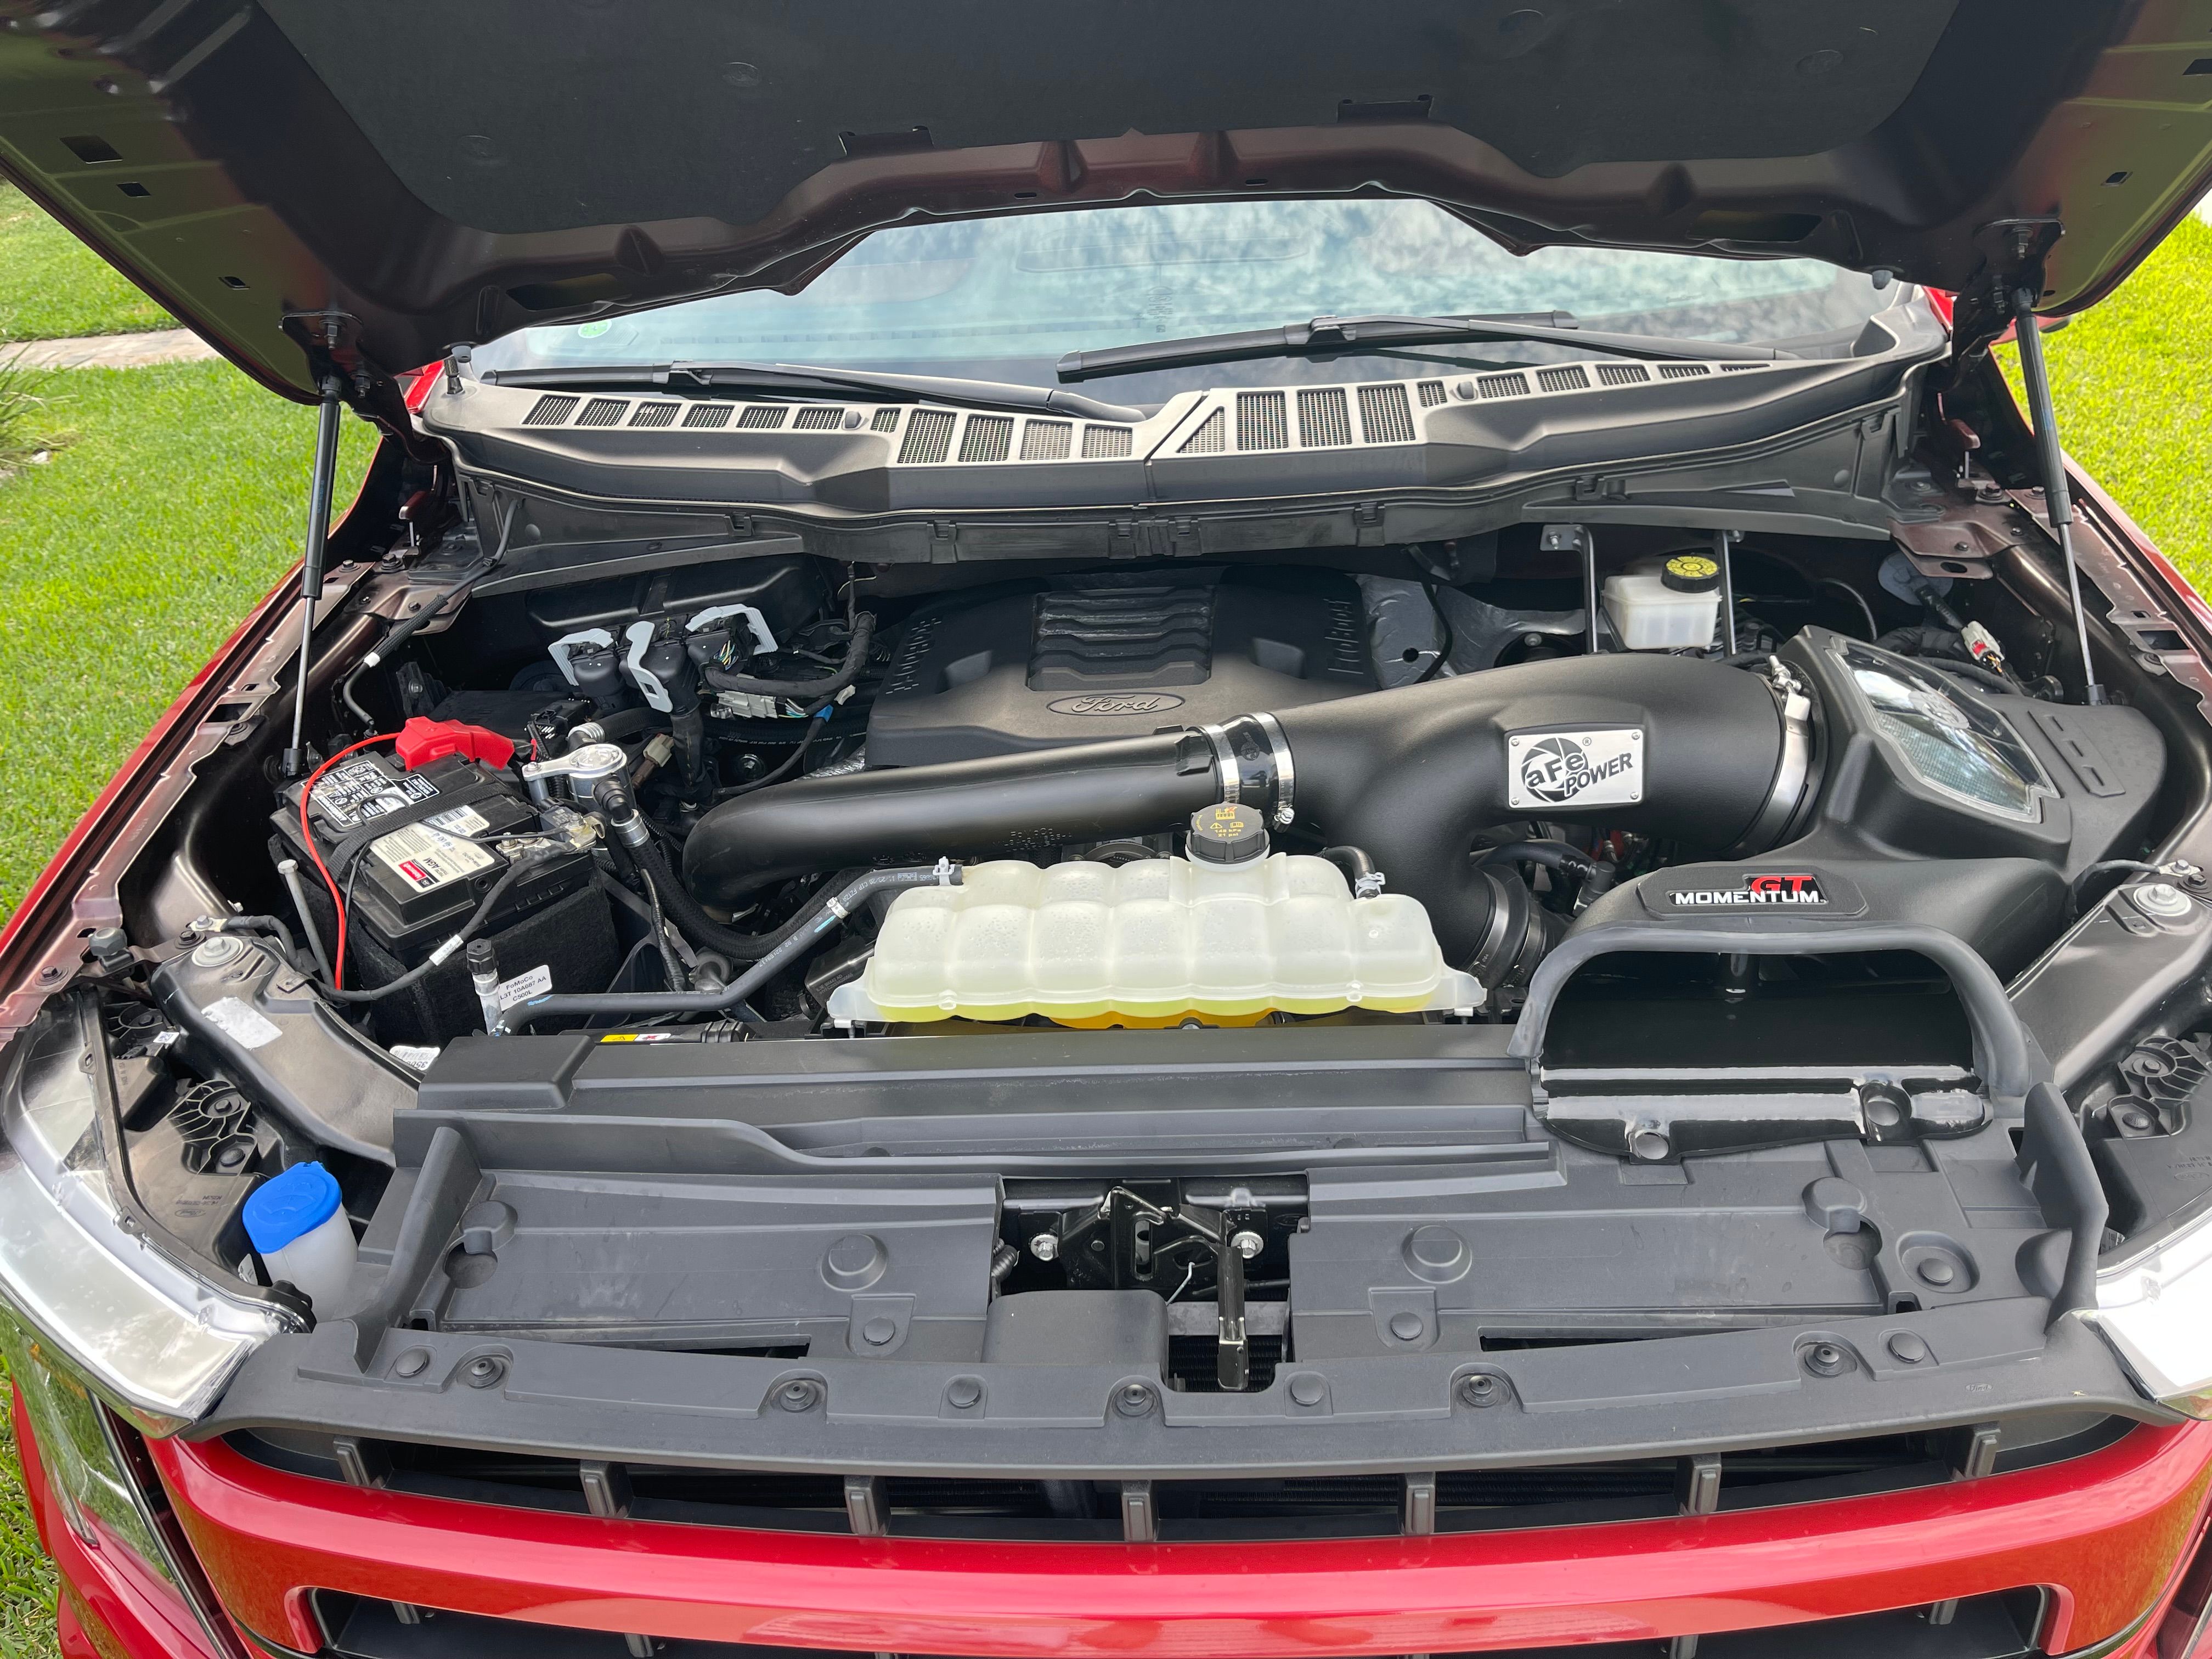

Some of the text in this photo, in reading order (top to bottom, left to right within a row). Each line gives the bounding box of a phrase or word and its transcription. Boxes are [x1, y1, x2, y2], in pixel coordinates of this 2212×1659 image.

[1072, 695, 1160, 713] Ford
[1526, 752, 1584, 787] aFe
[1566, 752, 1633, 795] POWER
[421, 856, 441, 870] AGM
[1751, 876, 1813, 894] GT
[1675, 891, 1818, 904] MOMENTUM
[506, 976, 533, 990] FoMoCo
[512, 990, 532, 1001] C500L
